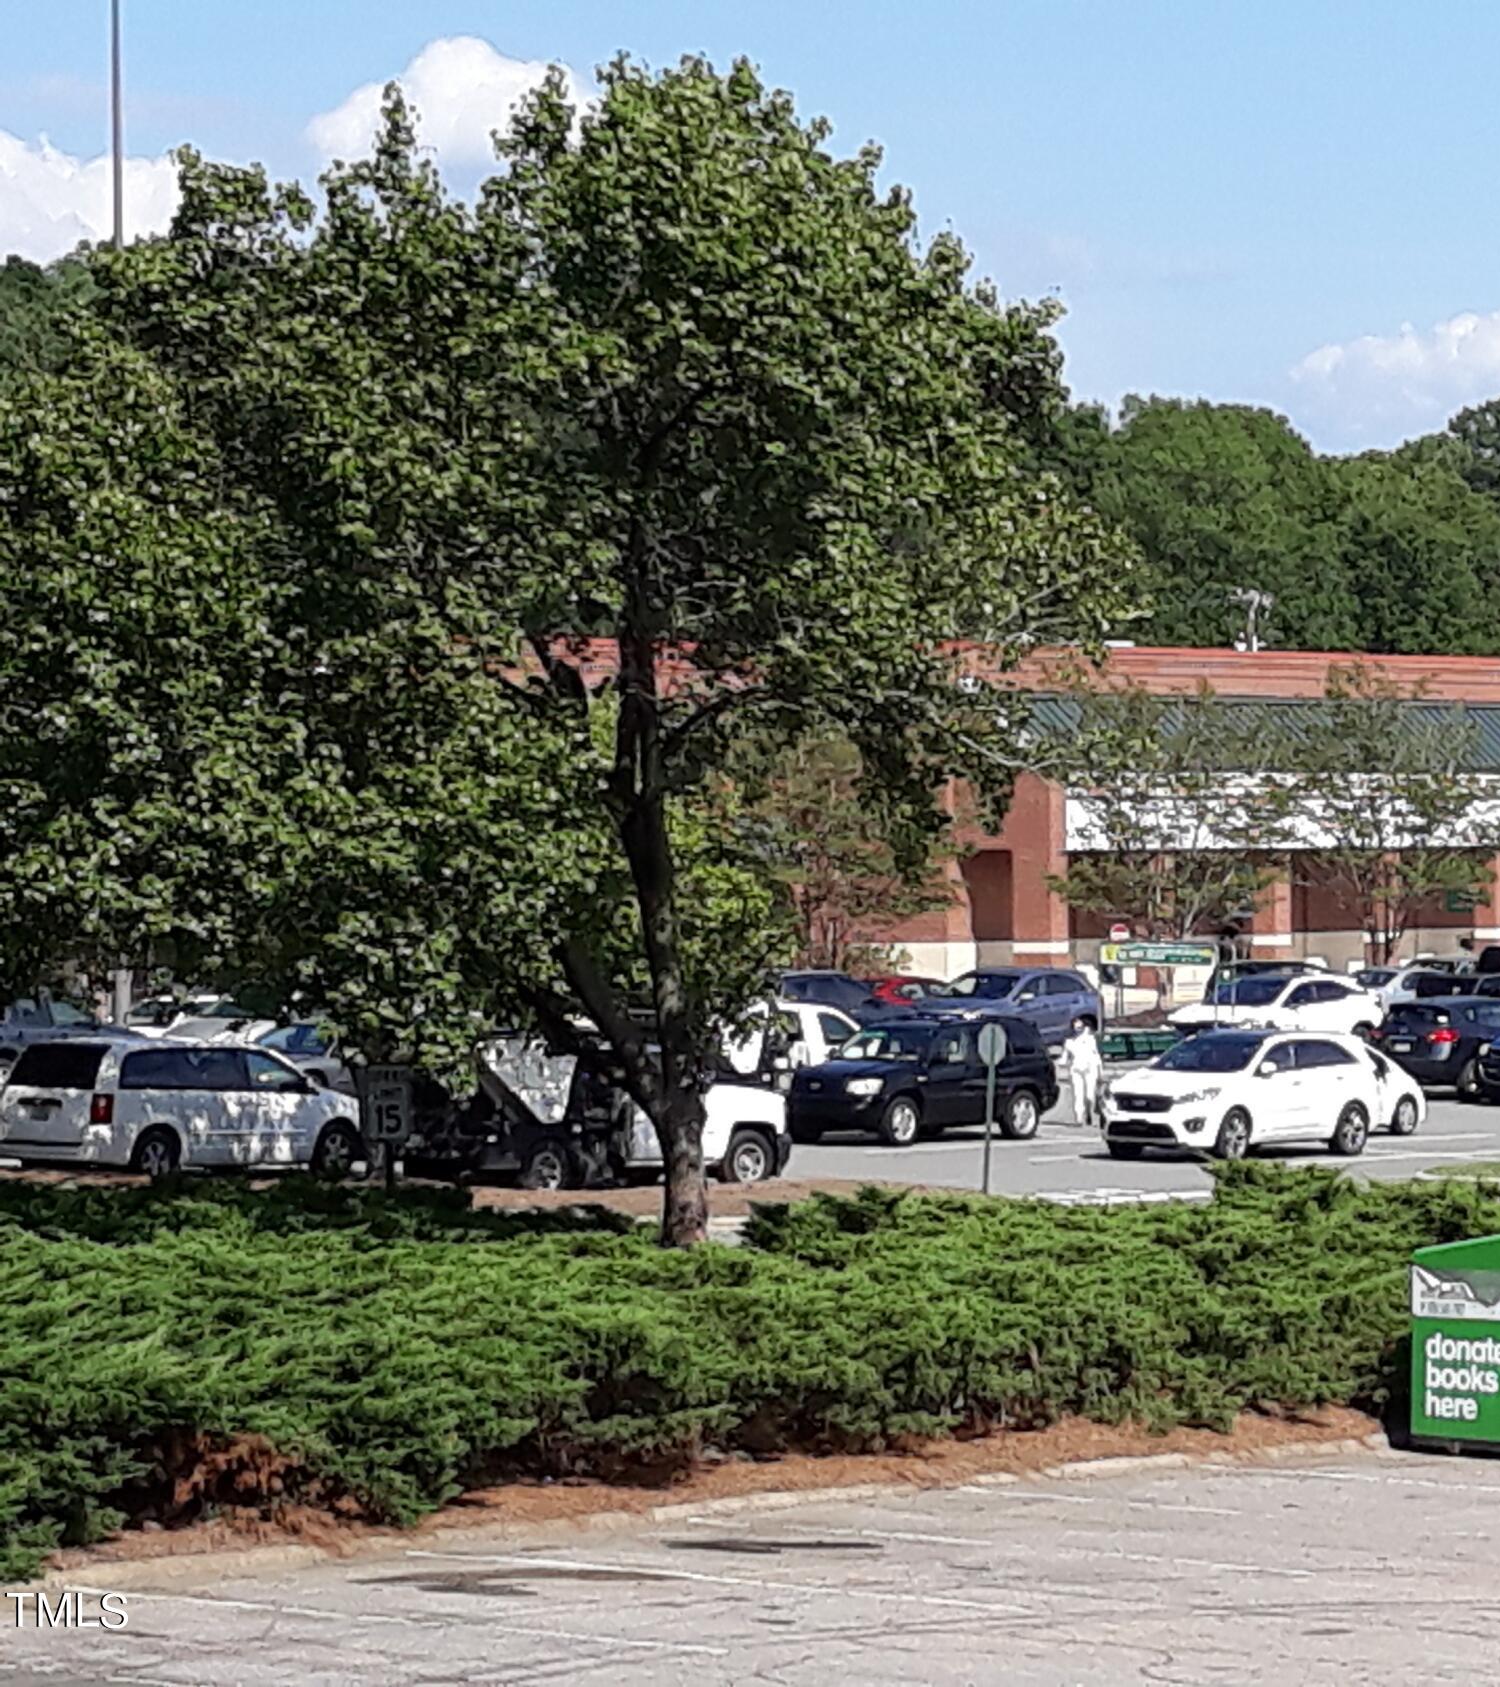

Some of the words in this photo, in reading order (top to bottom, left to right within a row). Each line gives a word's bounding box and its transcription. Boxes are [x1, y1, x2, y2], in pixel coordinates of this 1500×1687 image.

[375, 1104, 402, 1134] 15
[1426, 1360, 1500, 1393] books
[1425, 1389, 1478, 1420] here
